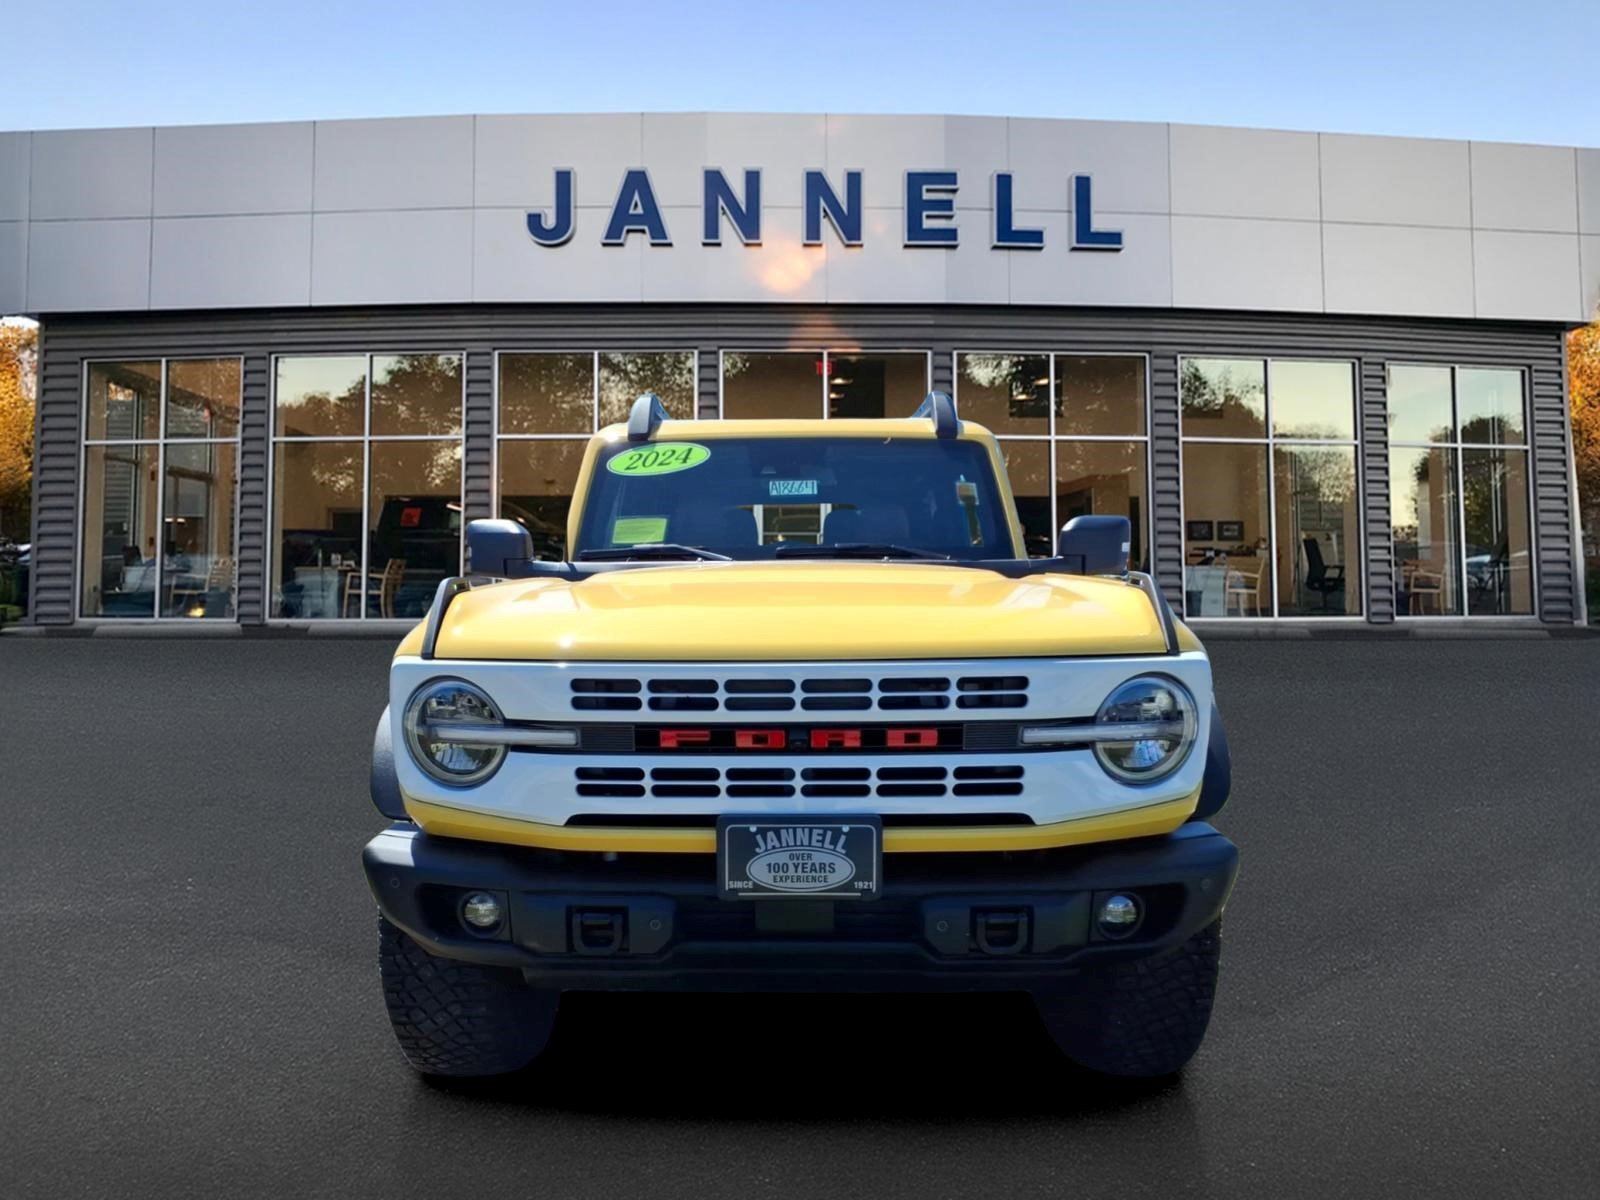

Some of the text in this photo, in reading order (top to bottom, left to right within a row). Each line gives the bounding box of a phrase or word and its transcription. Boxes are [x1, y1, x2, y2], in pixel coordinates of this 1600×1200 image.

[526, 166, 1124, 250] JANNELL
[624, 446, 693, 471] 2024
[660, 729, 938, 748] FORD
[755, 827, 848, 854] JANNELL
[789, 852, 813, 862] OVER
[766, 862, 836, 874] 100 YEARS
[729, 881, 754, 889] SINCE
[773, 875, 829, 883] EXPERIENCE
[854, 881, 873, 889] 1921
